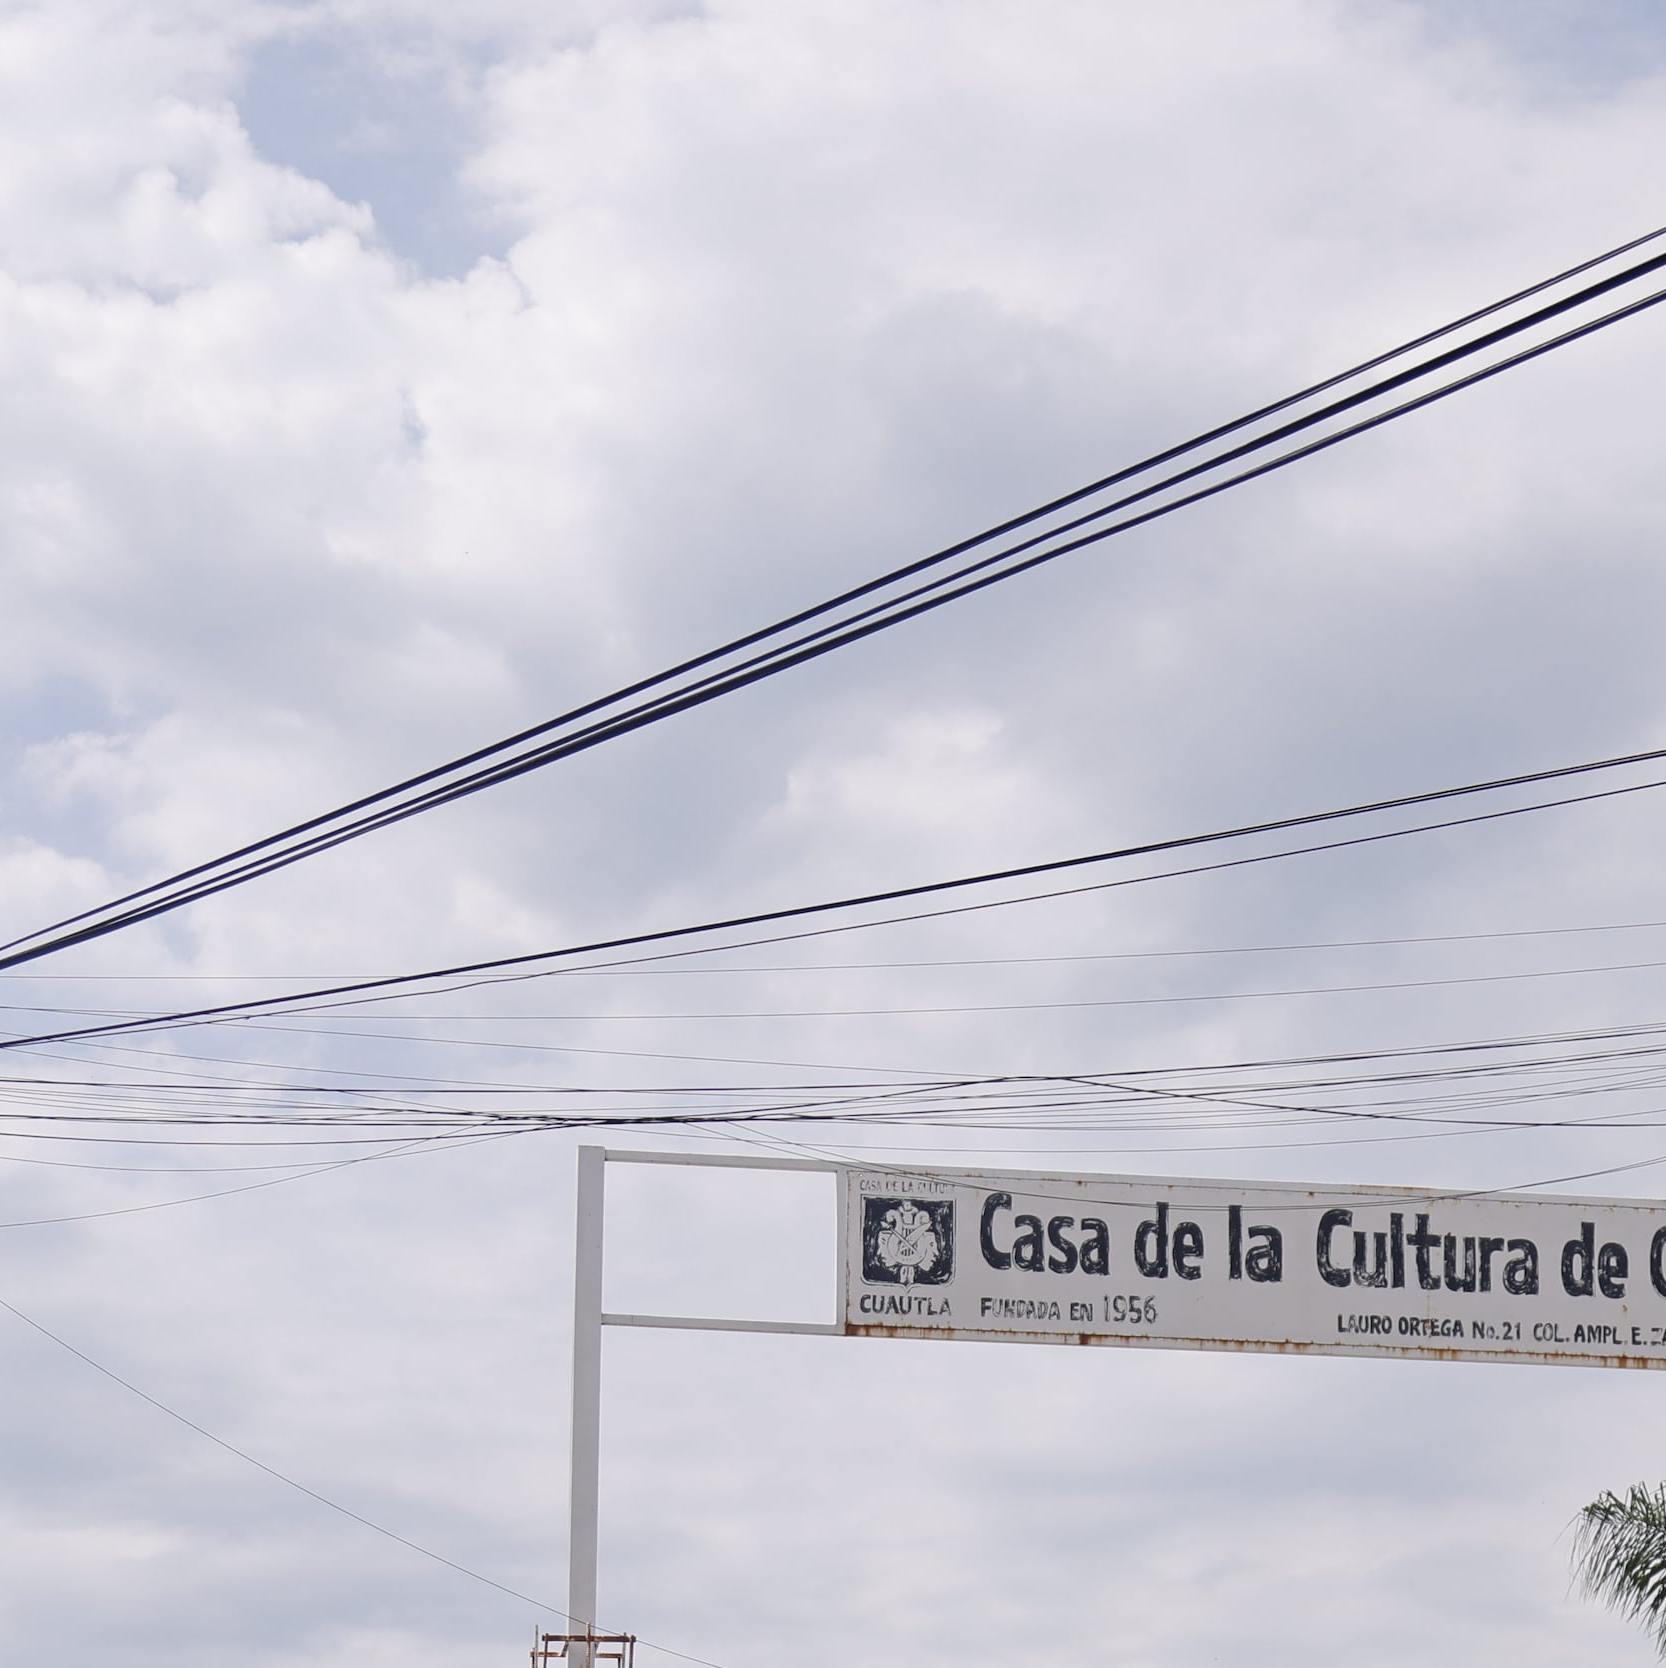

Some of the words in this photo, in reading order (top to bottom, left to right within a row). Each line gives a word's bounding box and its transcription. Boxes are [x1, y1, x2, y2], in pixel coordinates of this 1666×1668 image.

[979, 1192, 1111, 1276] Casa
[1133, 1201, 1205, 1281] de
[1228, 1204, 1284, 1284] la
[1315, 1208, 1539, 1296] Cultura
[1561, 1221, 1629, 1299] de
[860, 1294, 952, 1316] CUAUTLA
[981, 1297, 1061, 1321] FUNDADA
[1070, 1302, 1093, 1322] EN
[1103, 1294, 1158, 1324] 1956
[1337, 1314, 1393, 1335] LAURO
[1397, 1317, 1465, 1339] ORTEGA
[1533, 1323, 1570, 1344] COL.
[1631, 1326, 1649, 1346] E.
